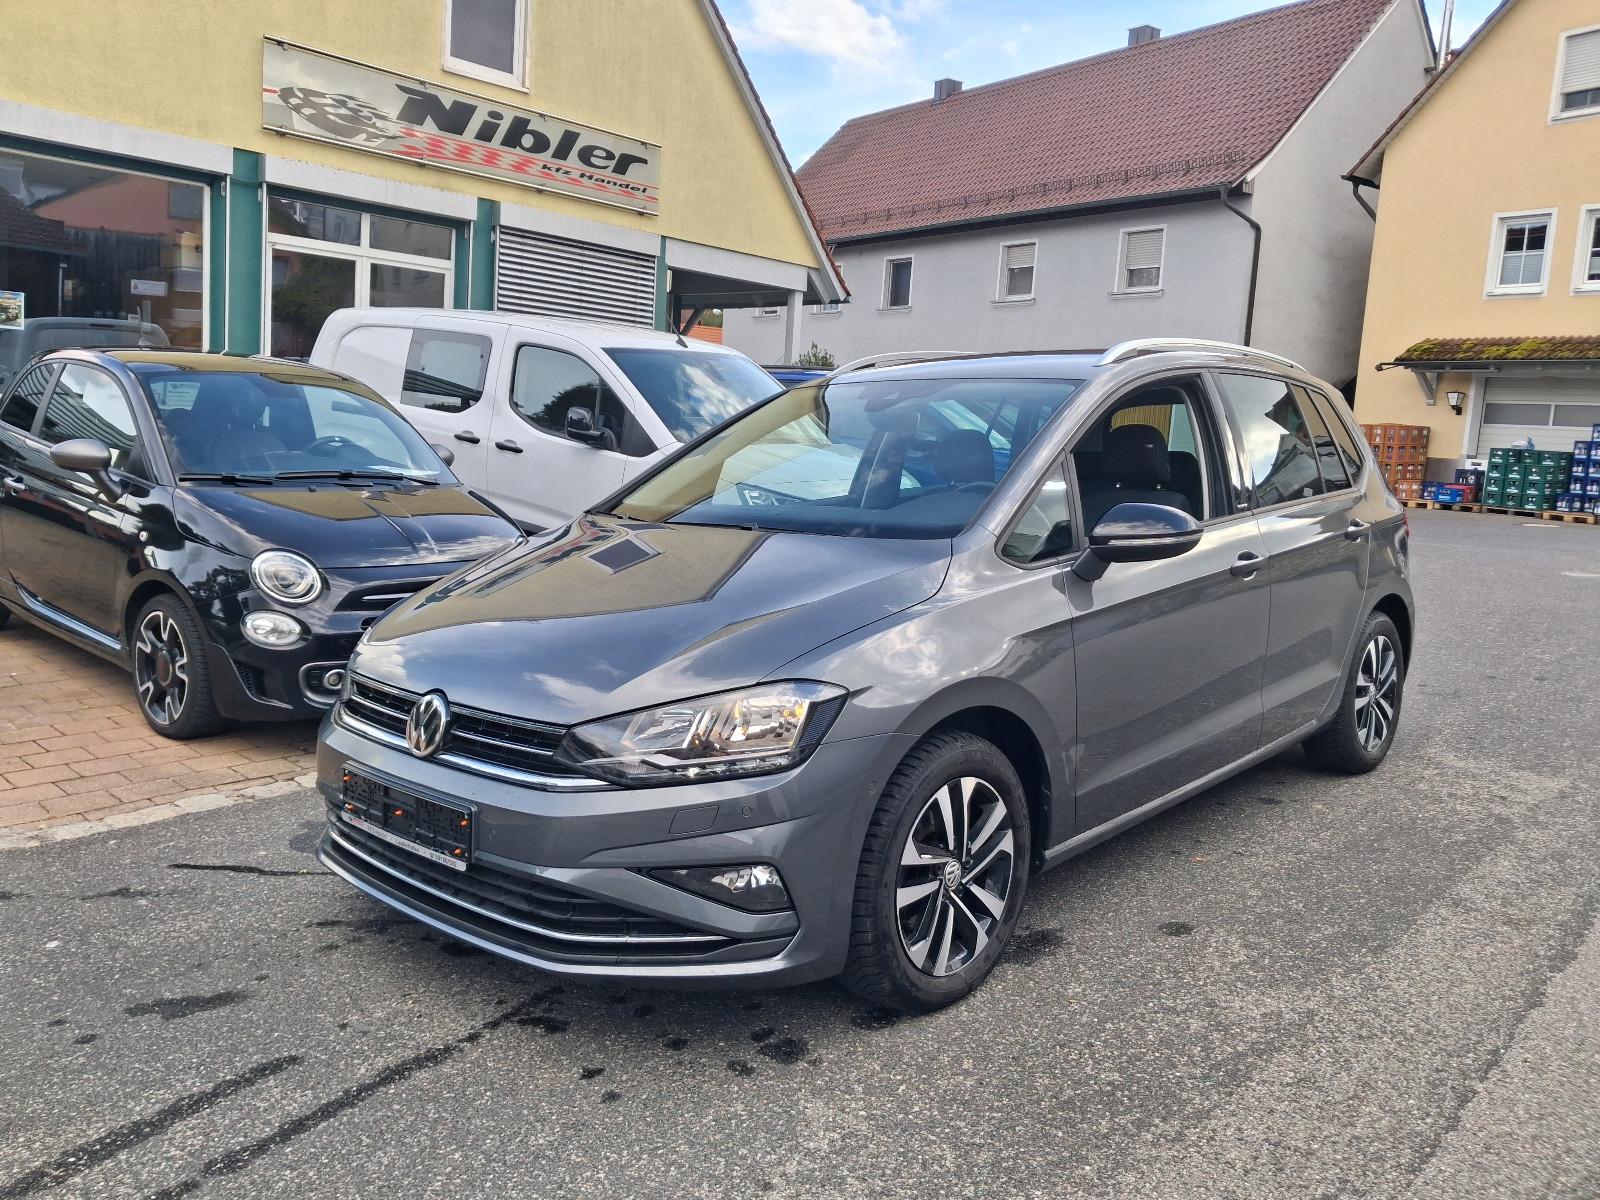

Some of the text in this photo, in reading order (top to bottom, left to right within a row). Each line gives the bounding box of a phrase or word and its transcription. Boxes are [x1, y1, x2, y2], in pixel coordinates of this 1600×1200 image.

[395, 83, 648, 176] Nibler
[579, 172, 648, 194] Handel
[406, 695, 446, 757] VW
